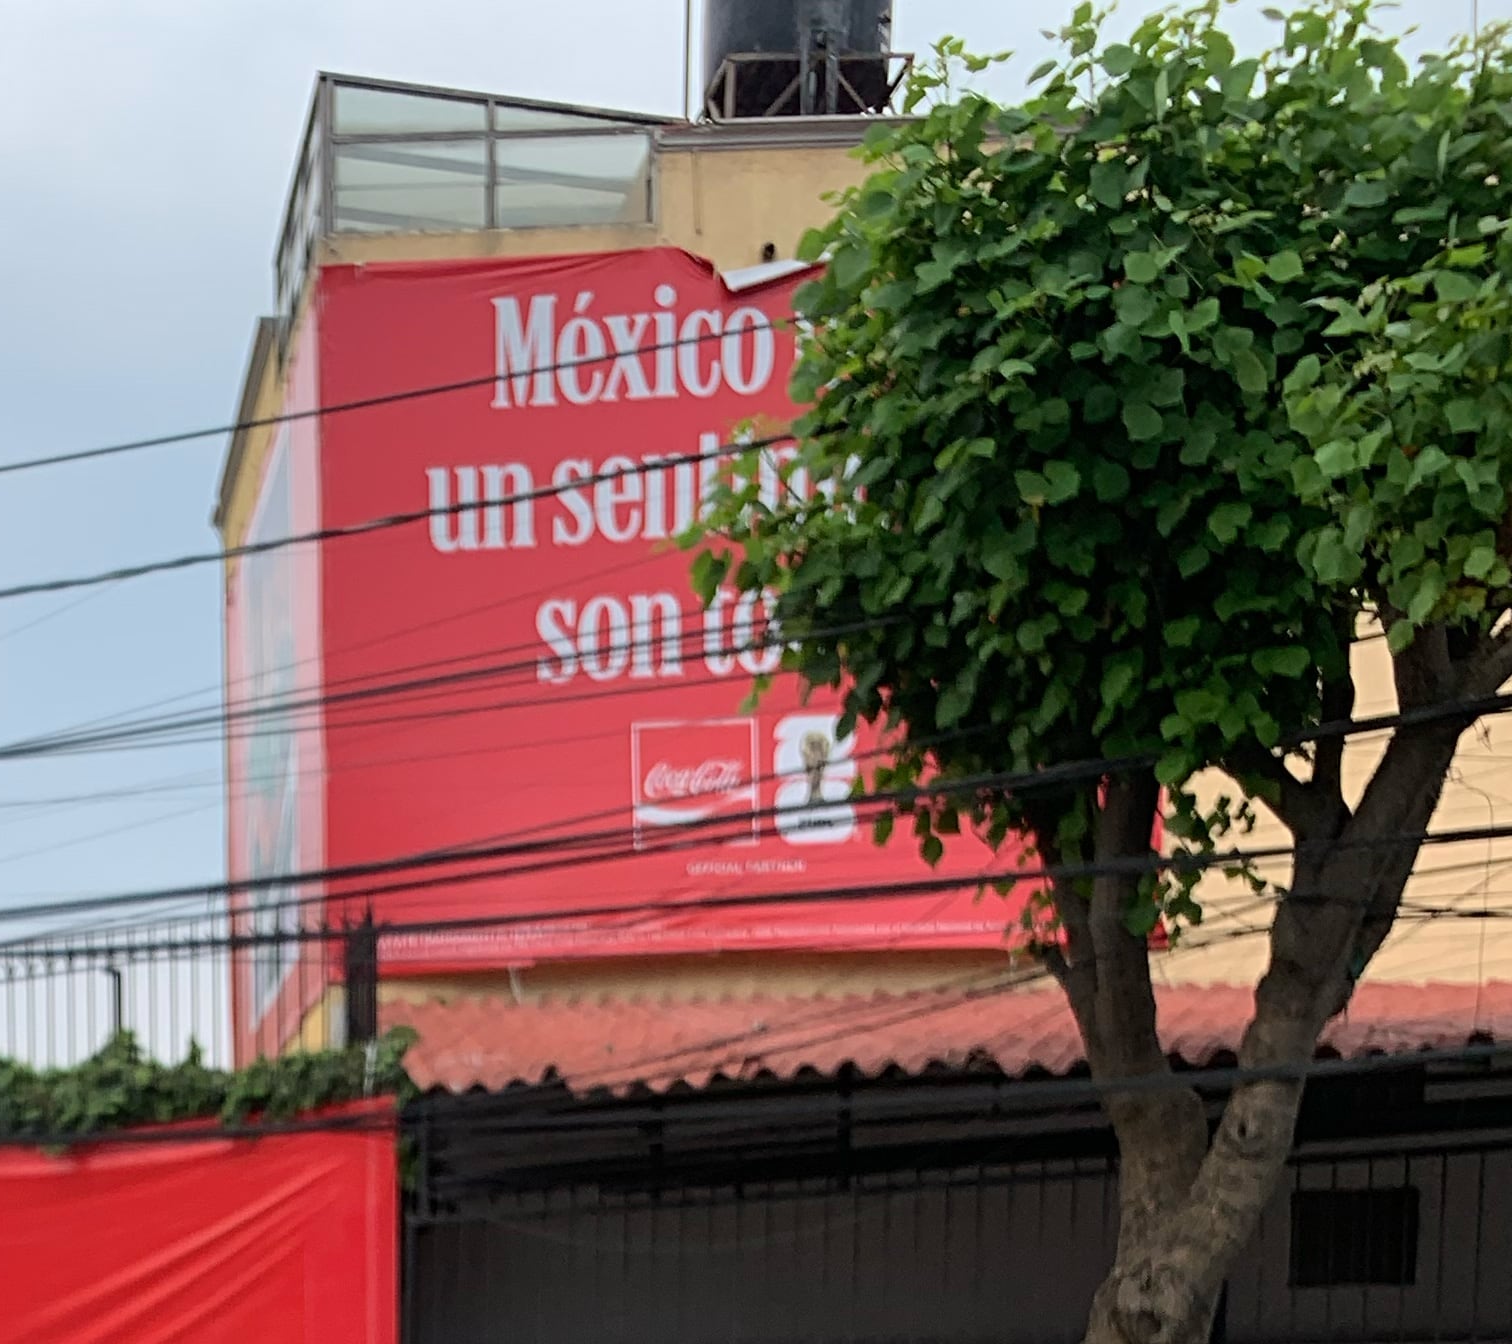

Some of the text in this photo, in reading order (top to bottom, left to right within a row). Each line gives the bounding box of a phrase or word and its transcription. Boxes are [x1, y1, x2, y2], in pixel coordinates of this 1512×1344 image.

[490, 284, 776, 410] México
[425, 462, 537, 553] un
[534, 590, 685, 685] son
